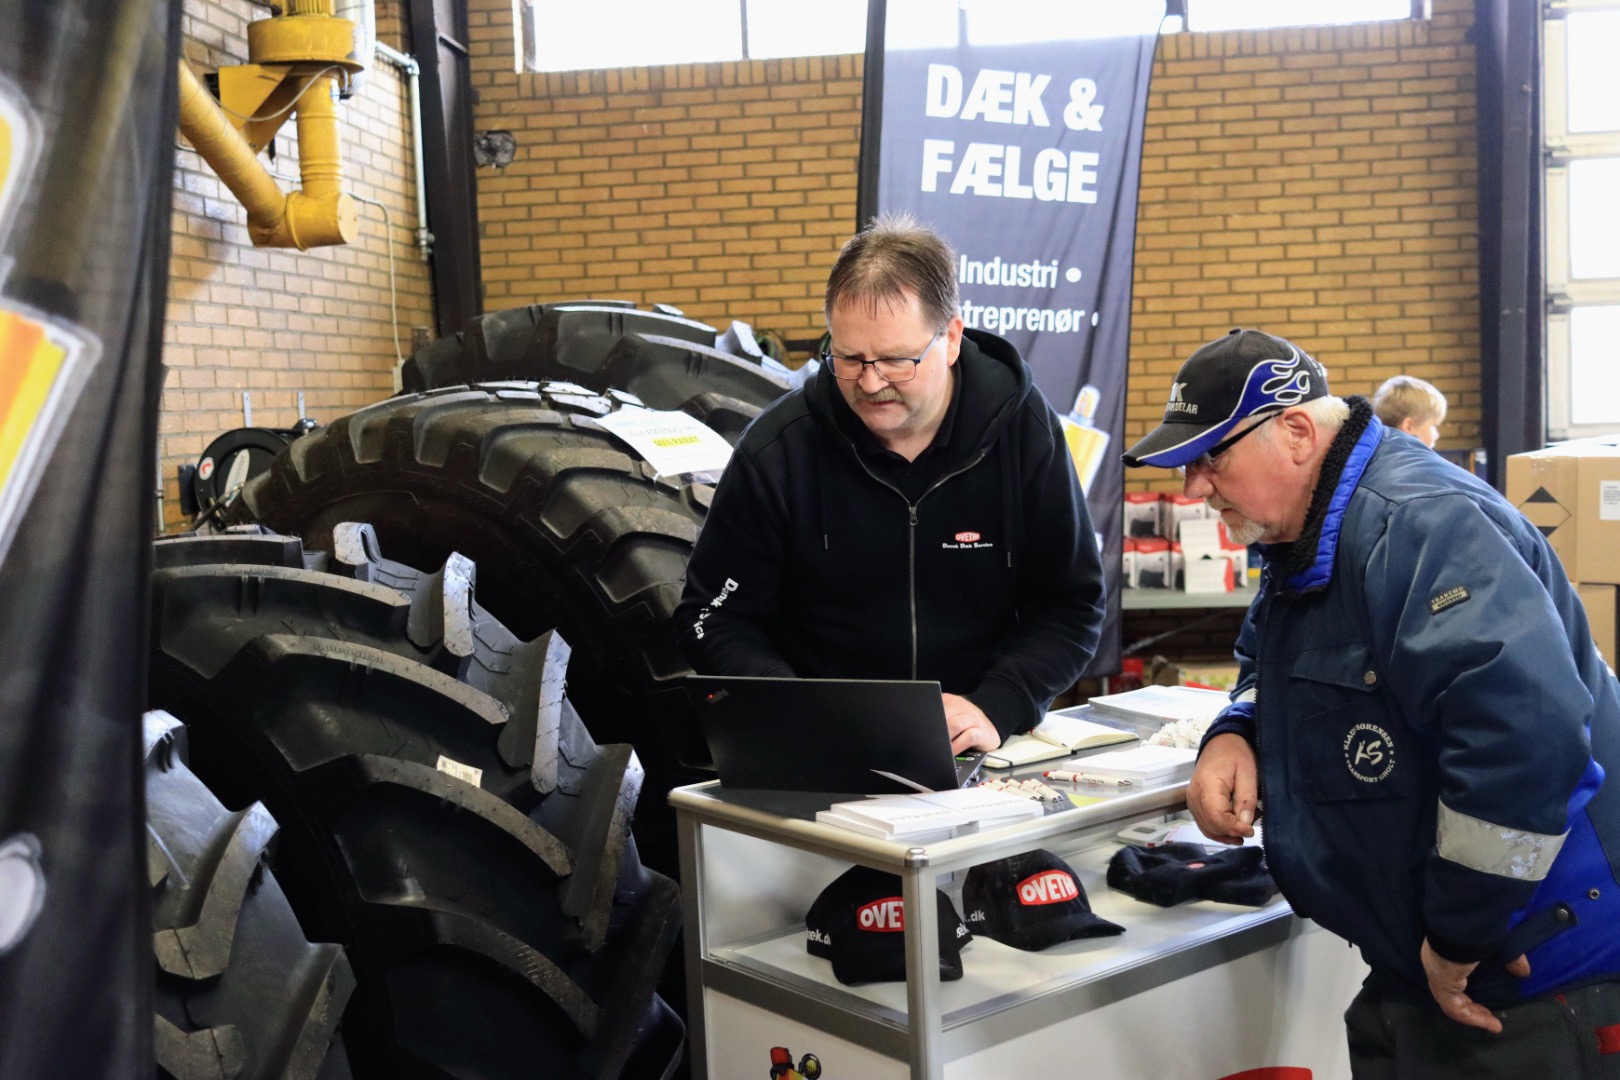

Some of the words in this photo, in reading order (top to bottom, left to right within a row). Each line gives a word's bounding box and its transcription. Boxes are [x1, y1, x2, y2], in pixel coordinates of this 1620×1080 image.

[925, 63, 1051, 127] DÆK
[1063, 77, 1104, 132] &
[921, 138, 1099, 204] FÆLGE
[959, 254, 1058, 289] Industri
[960, 299, 1086, 336] treprenør
[860, 900, 905, 929] OVE
